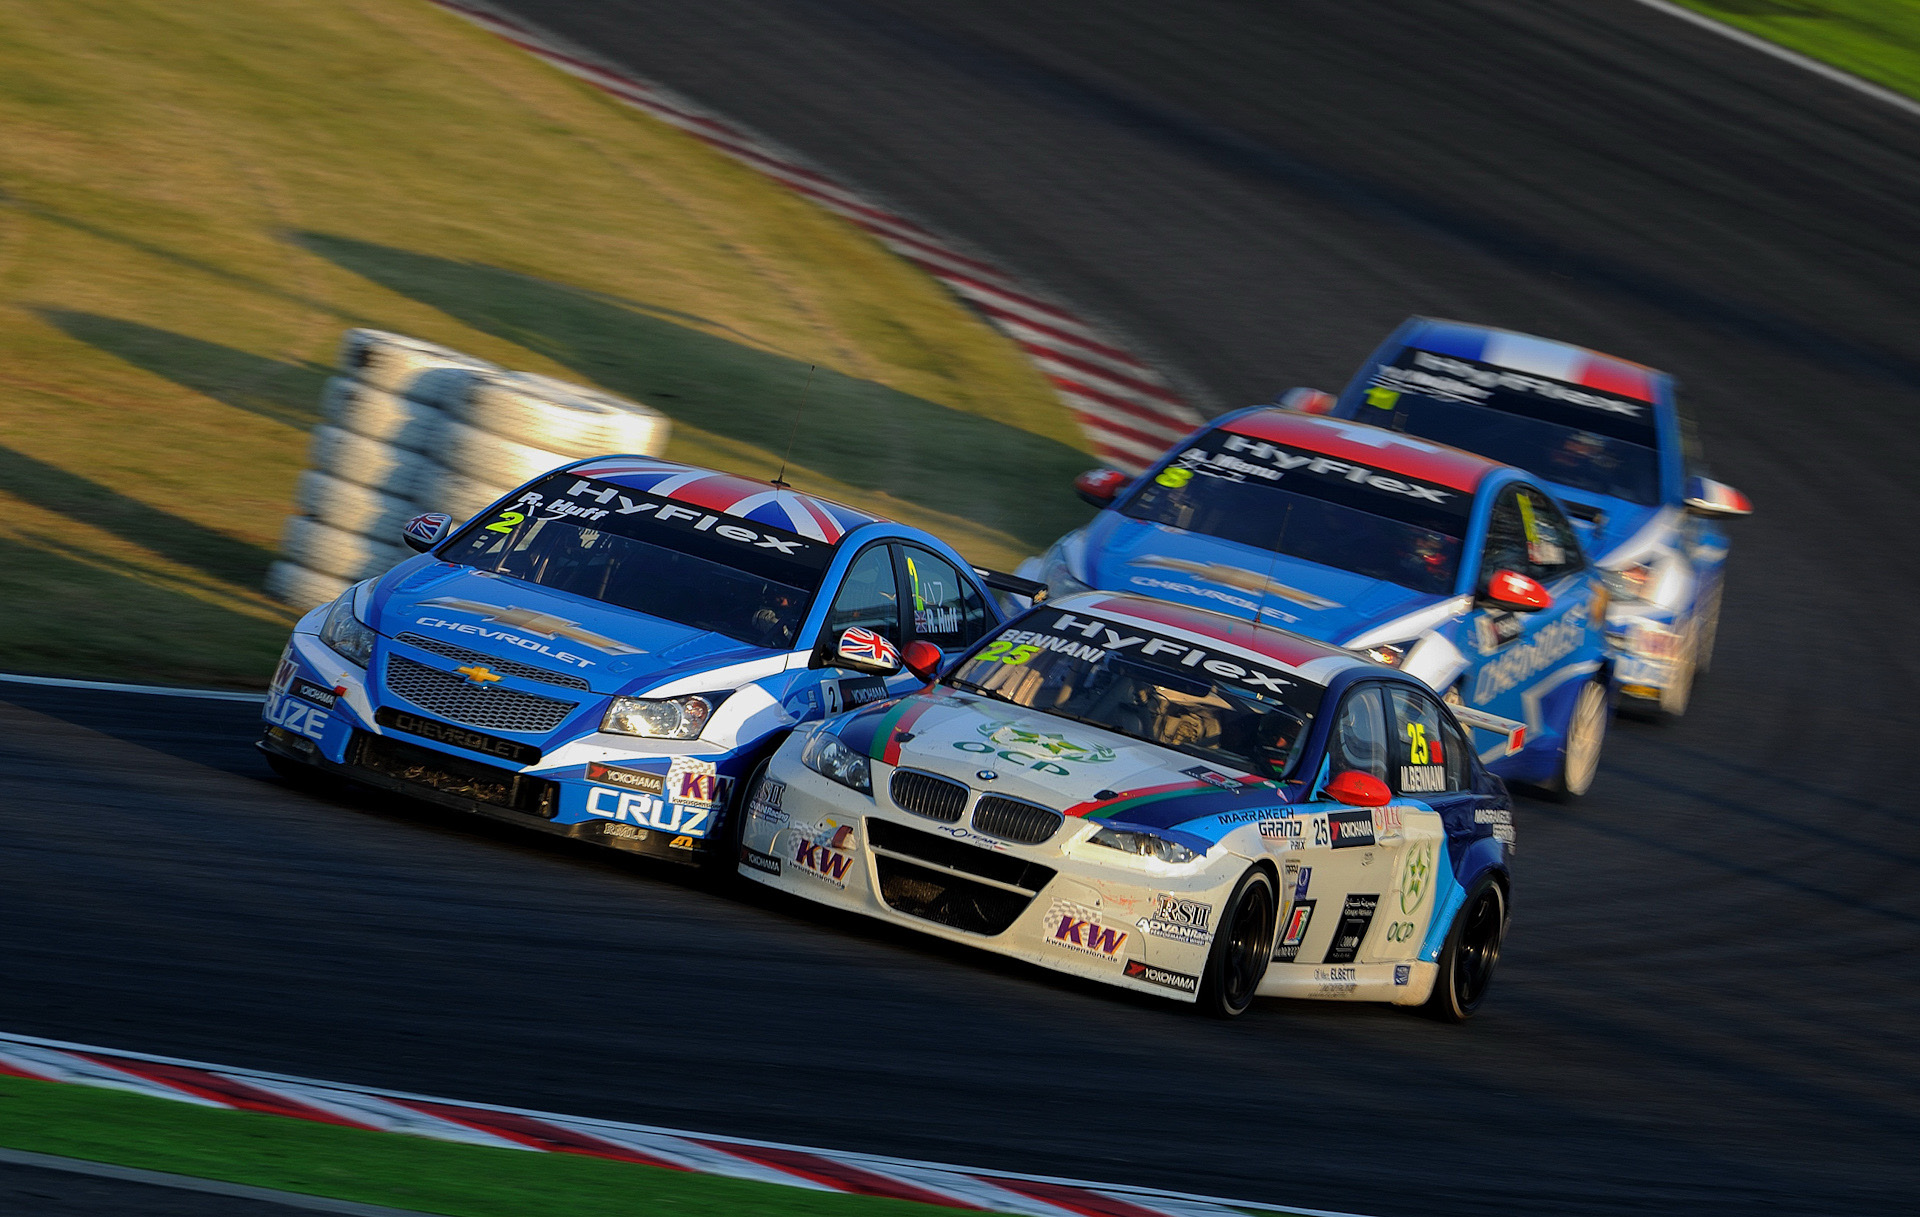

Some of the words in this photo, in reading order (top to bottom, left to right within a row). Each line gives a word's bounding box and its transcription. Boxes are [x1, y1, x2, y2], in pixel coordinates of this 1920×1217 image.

[1155, 466, 1195, 488] 8
[1223, 434, 1456, 504] HyFlex
[518, 491, 543, 507] R.
[545, 499, 609, 521] Huff
[566, 479, 803, 555] HyFlex
[485, 511, 525, 534] 2
[907, 557, 924, 611] 2
[1130, 575, 1302, 624] CHEVROLET
[415, 615, 596, 669] CHEVROLET
[974, 640, 1041, 665] 25
[996, 628, 1105, 663] BENNANI
[1053, 613, 1292, 694] HyFlex
[828, 686, 838, 713] 2
[851, 686, 888, 704] YOKOHAMA
[396, 714, 525, 759] CHEVROLET
[1407, 722, 1429, 765] 25
[606, 769, 663, 791] YOKOHAMA
[680, 771, 735, 804] KW
[1218, 807, 1294, 825] MARRAKECH
[1258, 821, 1303, 837] GRAND
[1290, 840, 1306, 851] PRIX
[1313, 818, 1328, 846] 25
[1339, 820, 1373, 838] YOKOHAMA
[796, 837, 854, 881] KW
[1055, 915, 1128, 955] KW
[1136, 916, 1192, 938] ADVAN
[1145, 967, 1195, 990] YOKOHAMA
